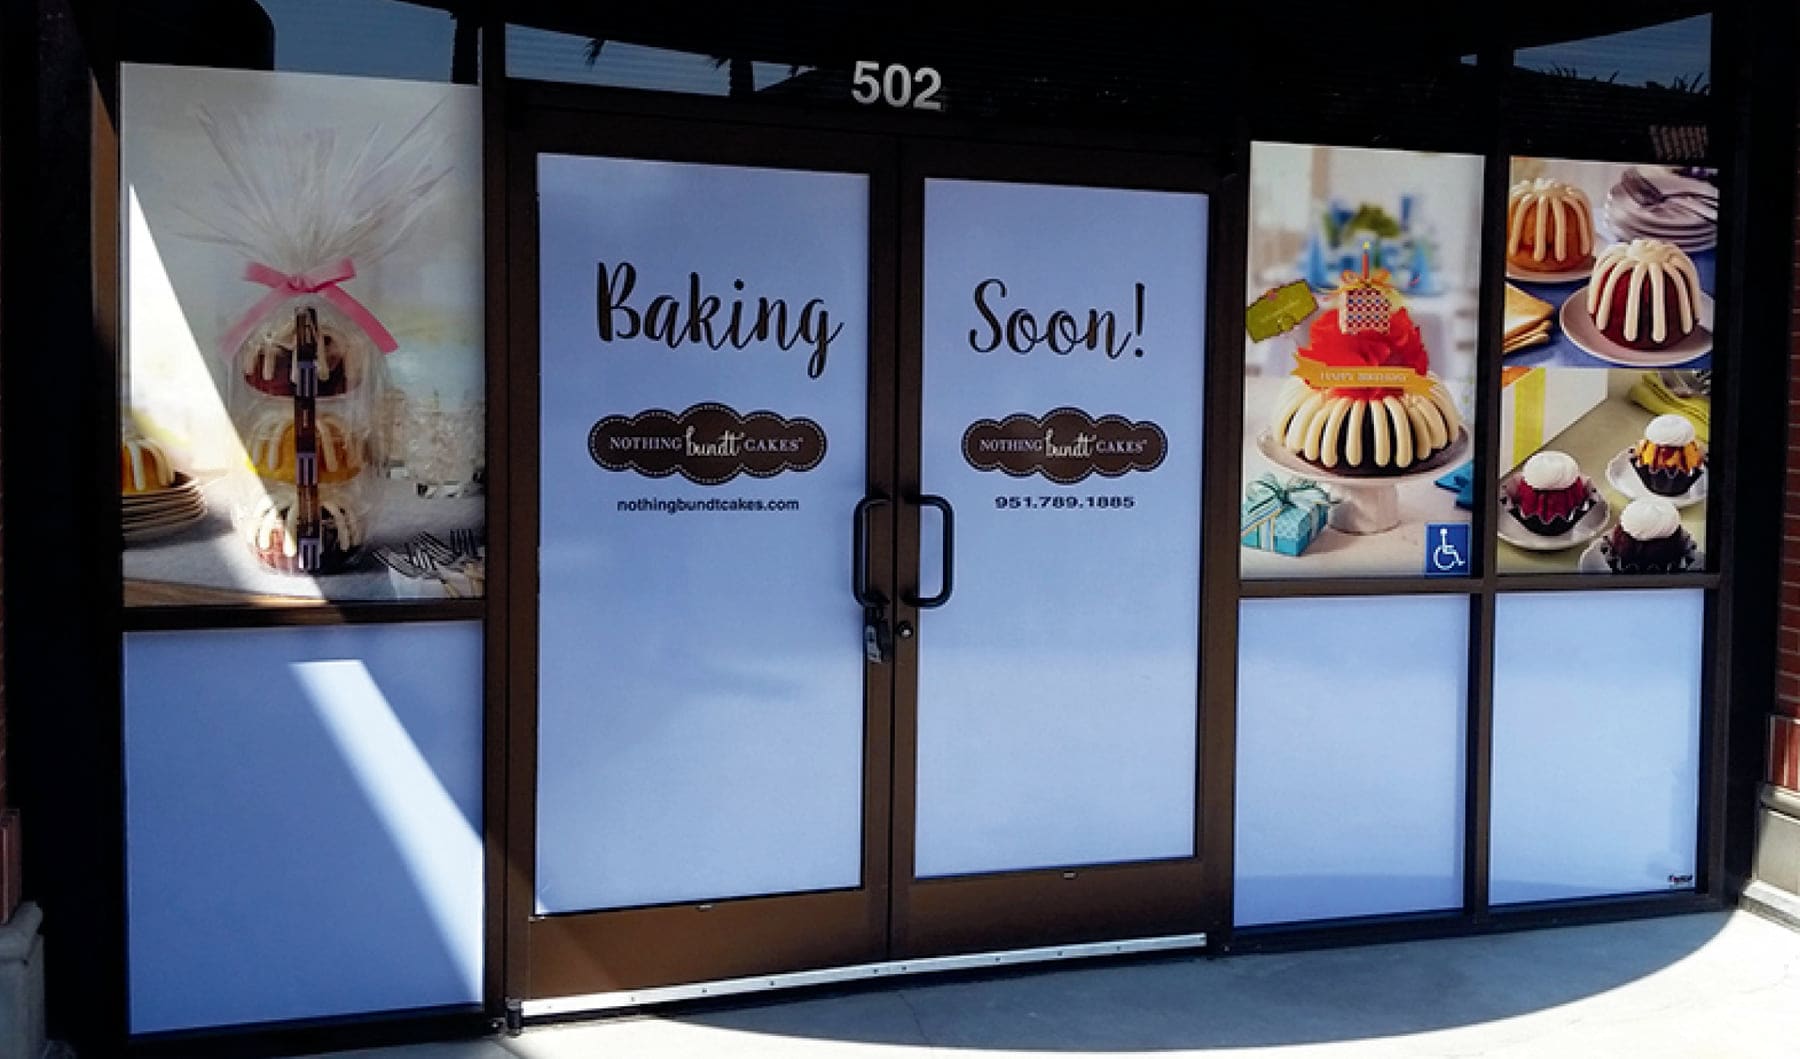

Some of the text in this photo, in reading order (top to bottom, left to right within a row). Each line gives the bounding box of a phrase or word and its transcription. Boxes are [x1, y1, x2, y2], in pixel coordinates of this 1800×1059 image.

[852, 60, 942, 110] 502
[596, 262, 844, 379] Baking
[969, 278, 1147, 359] Soon!
[609, 425, 799, 457] NOTHING bundt CAKES
[979, 428, 1144, 458] NOTHING bundt CAKES
[616, 497, 800, 514] nothingbundtcakes.com
[994, 495, 1136, 509] 951.789.1885
